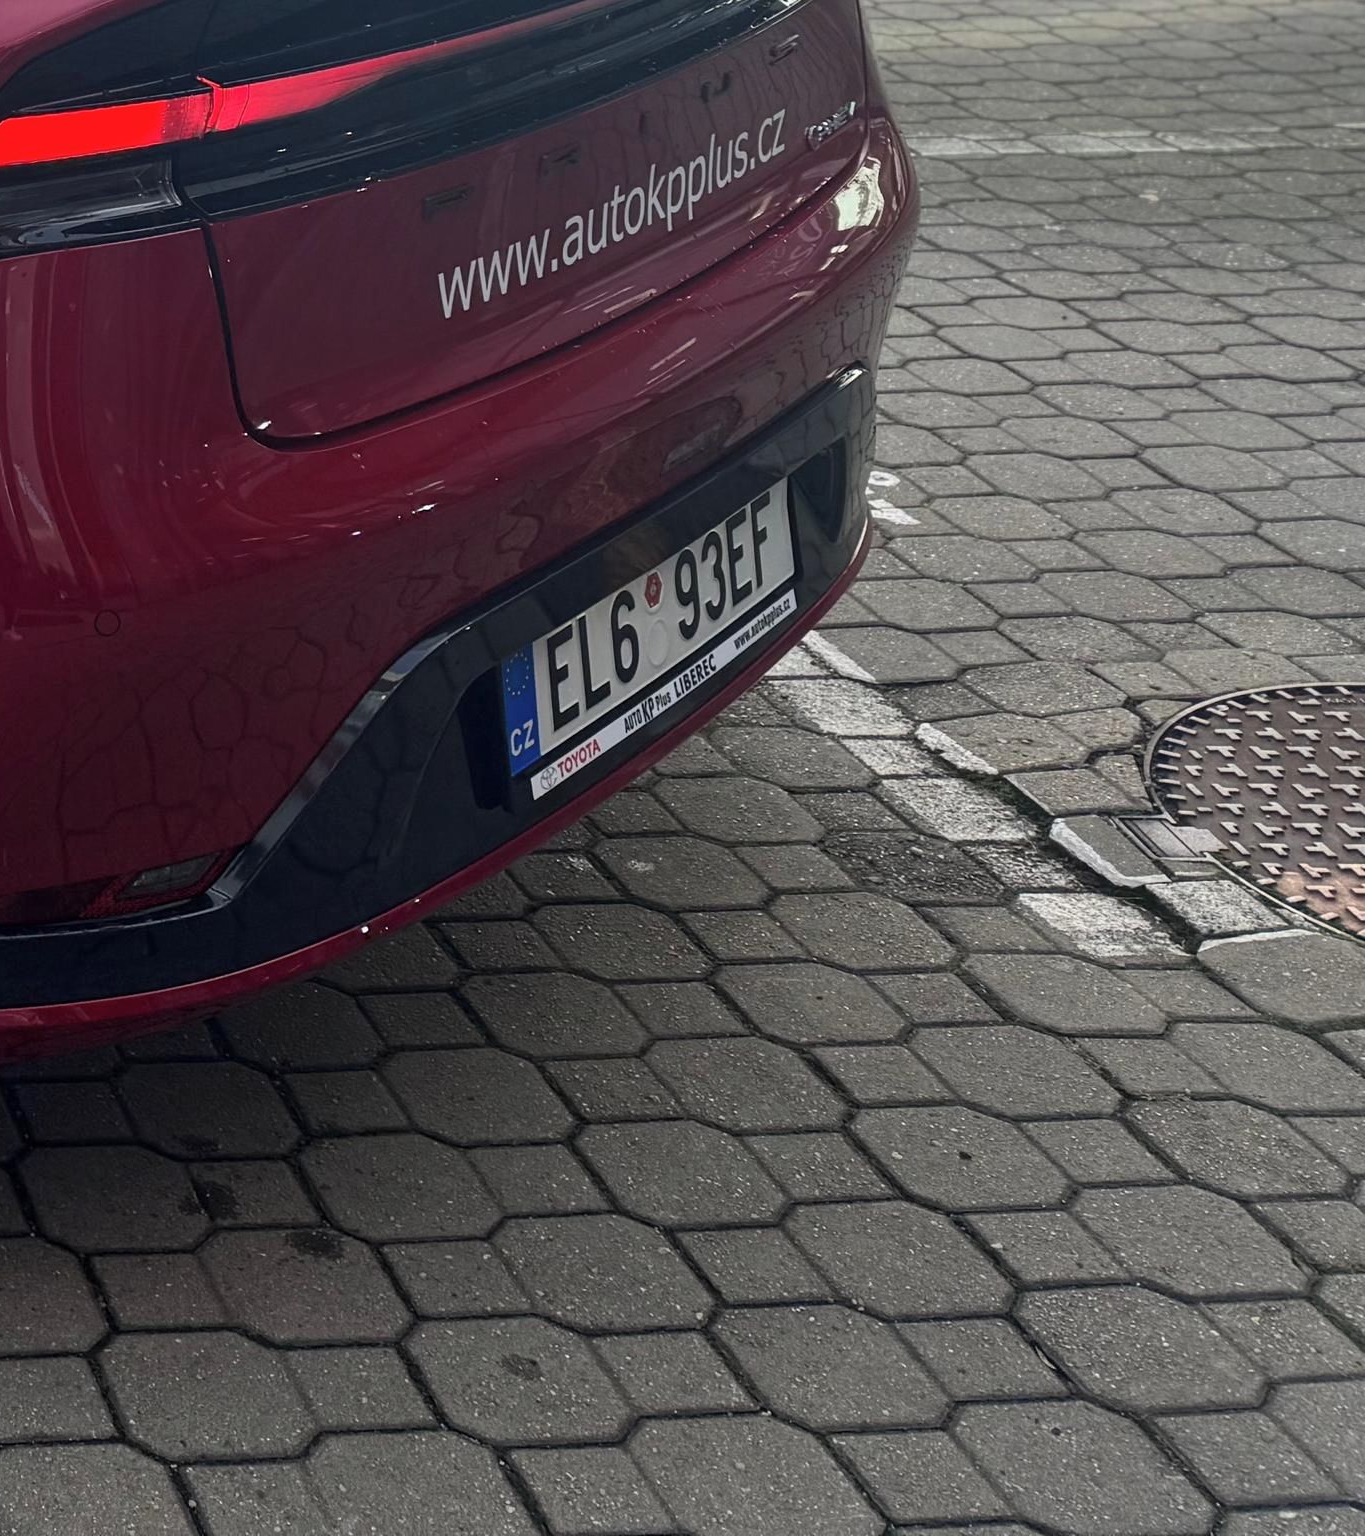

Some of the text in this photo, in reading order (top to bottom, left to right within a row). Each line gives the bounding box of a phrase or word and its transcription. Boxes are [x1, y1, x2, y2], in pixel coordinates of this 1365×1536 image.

[437, 108, 786, 320] www.autokpplus.cz
[546, 490, 771, 733] EL6 93EF
[510, 719, 535, 757] CZ
[557, 738, 601, 778] TOYOTA
[624, 707, 643, 734] AUTO
[642, 696, 655, 725] KP
[673, 653, 717, 698] LIBEREC
